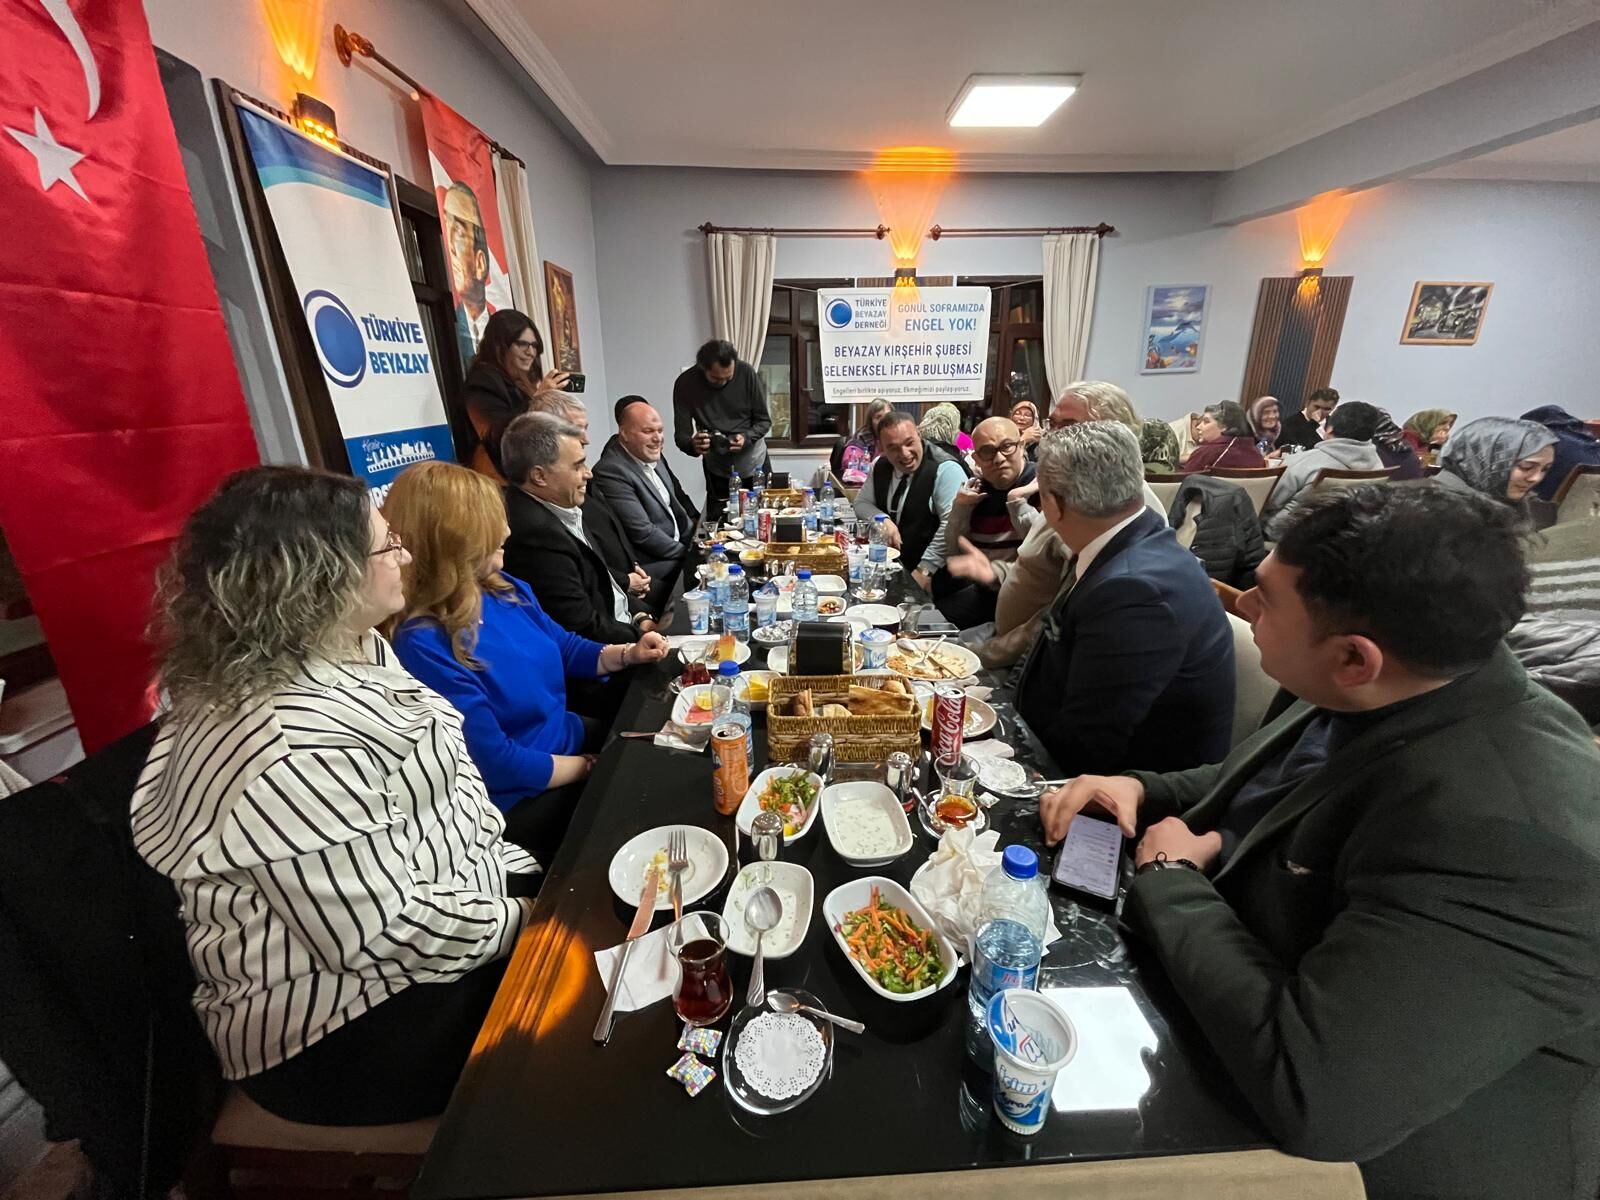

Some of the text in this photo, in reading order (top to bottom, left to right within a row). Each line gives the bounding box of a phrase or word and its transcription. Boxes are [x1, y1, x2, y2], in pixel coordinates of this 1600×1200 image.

[856, 297, 887, 307] TÜRKİYE
[930, 303, 985, 312] SOFRAMIZDA
[360, 313, 423, 344] TÜRKİYE
[855, 320, 887, 329] DERNEĞİ
[905, 318, 977, 331] ENGEL YOK!
[834, 341, 972, 359] BEYAZAY KIRŞEHİR ŞUBESİ
[368, 351, 430, 374] BEYAZAY
[824, 362, 983, 377] GELENEKSEL İFTAR BULUŞMASI
